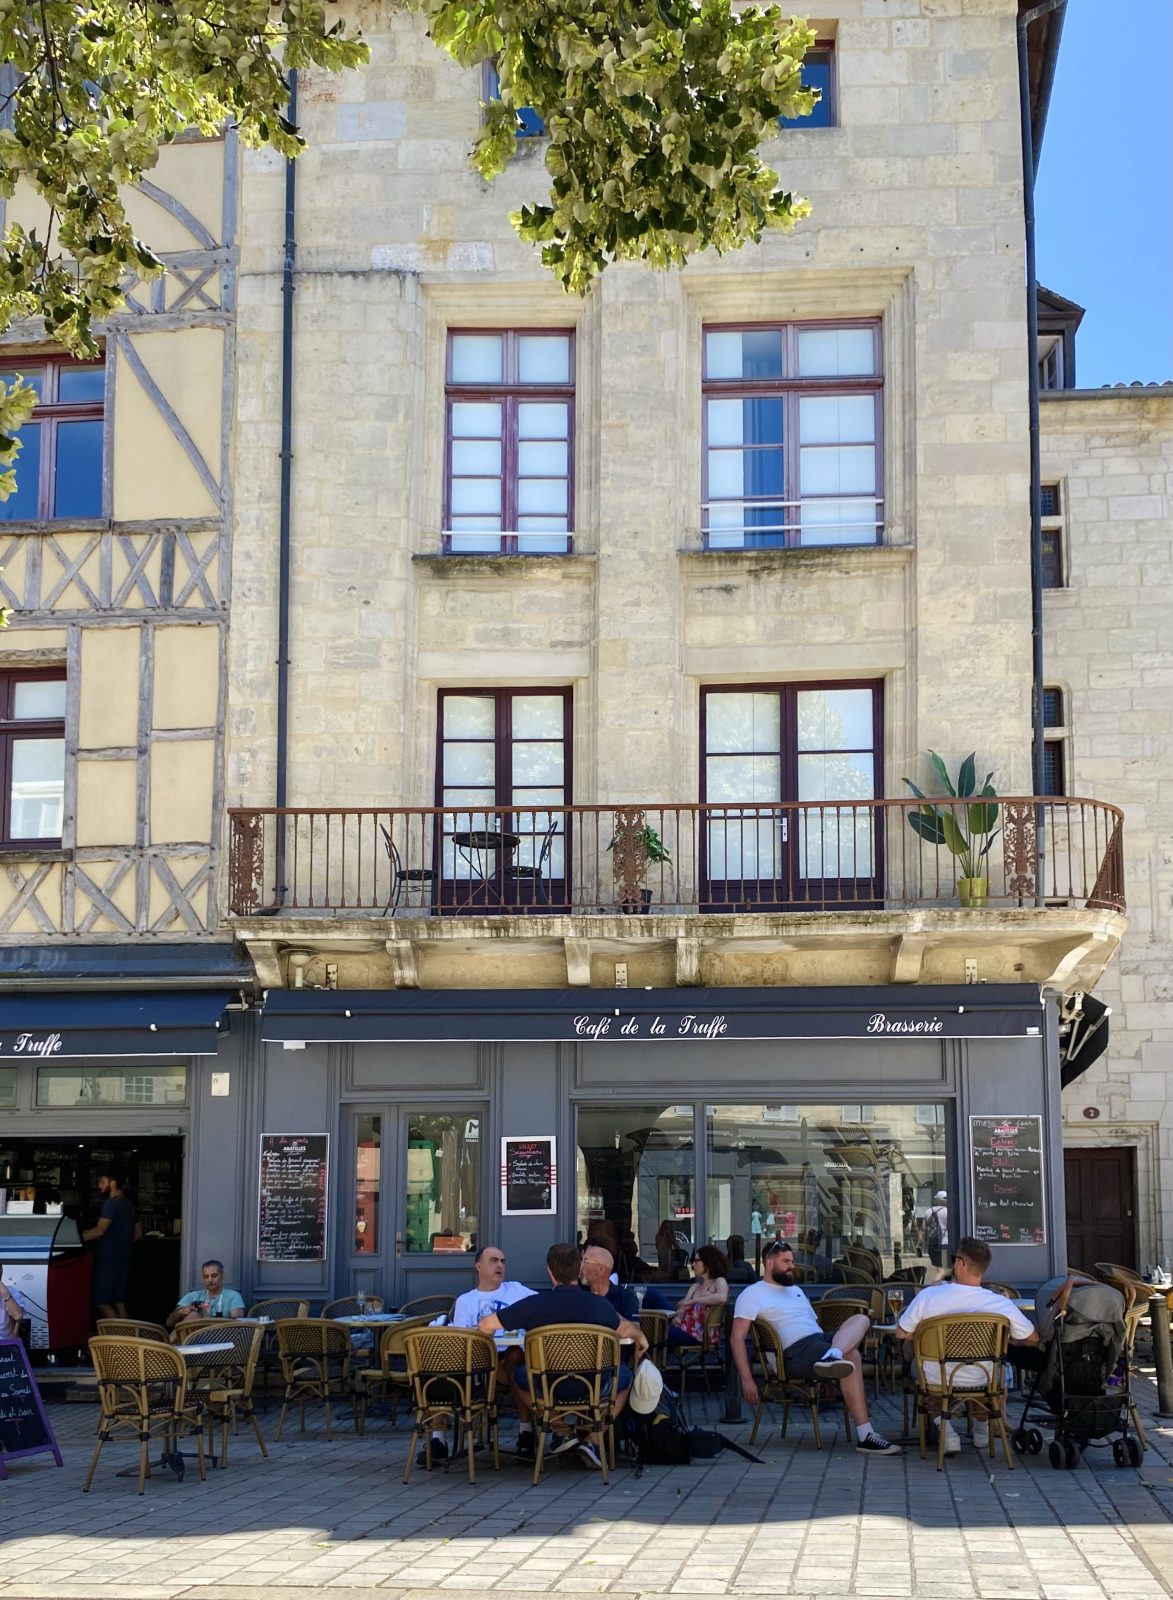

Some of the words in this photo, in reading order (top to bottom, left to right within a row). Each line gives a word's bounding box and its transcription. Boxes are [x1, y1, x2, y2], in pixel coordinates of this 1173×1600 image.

[573, 1016, 612, 1039] Café
[620, 1016, 639, 1034] de
[650, 1016, 666, 1034] la
[678, 1015, 728, 1038] Truffe
[866, 1013, 943, 1033] Brasserie
[13, 1033, 62, 1056] Truffe
[1089, 1108, 1095, 1117] 2
